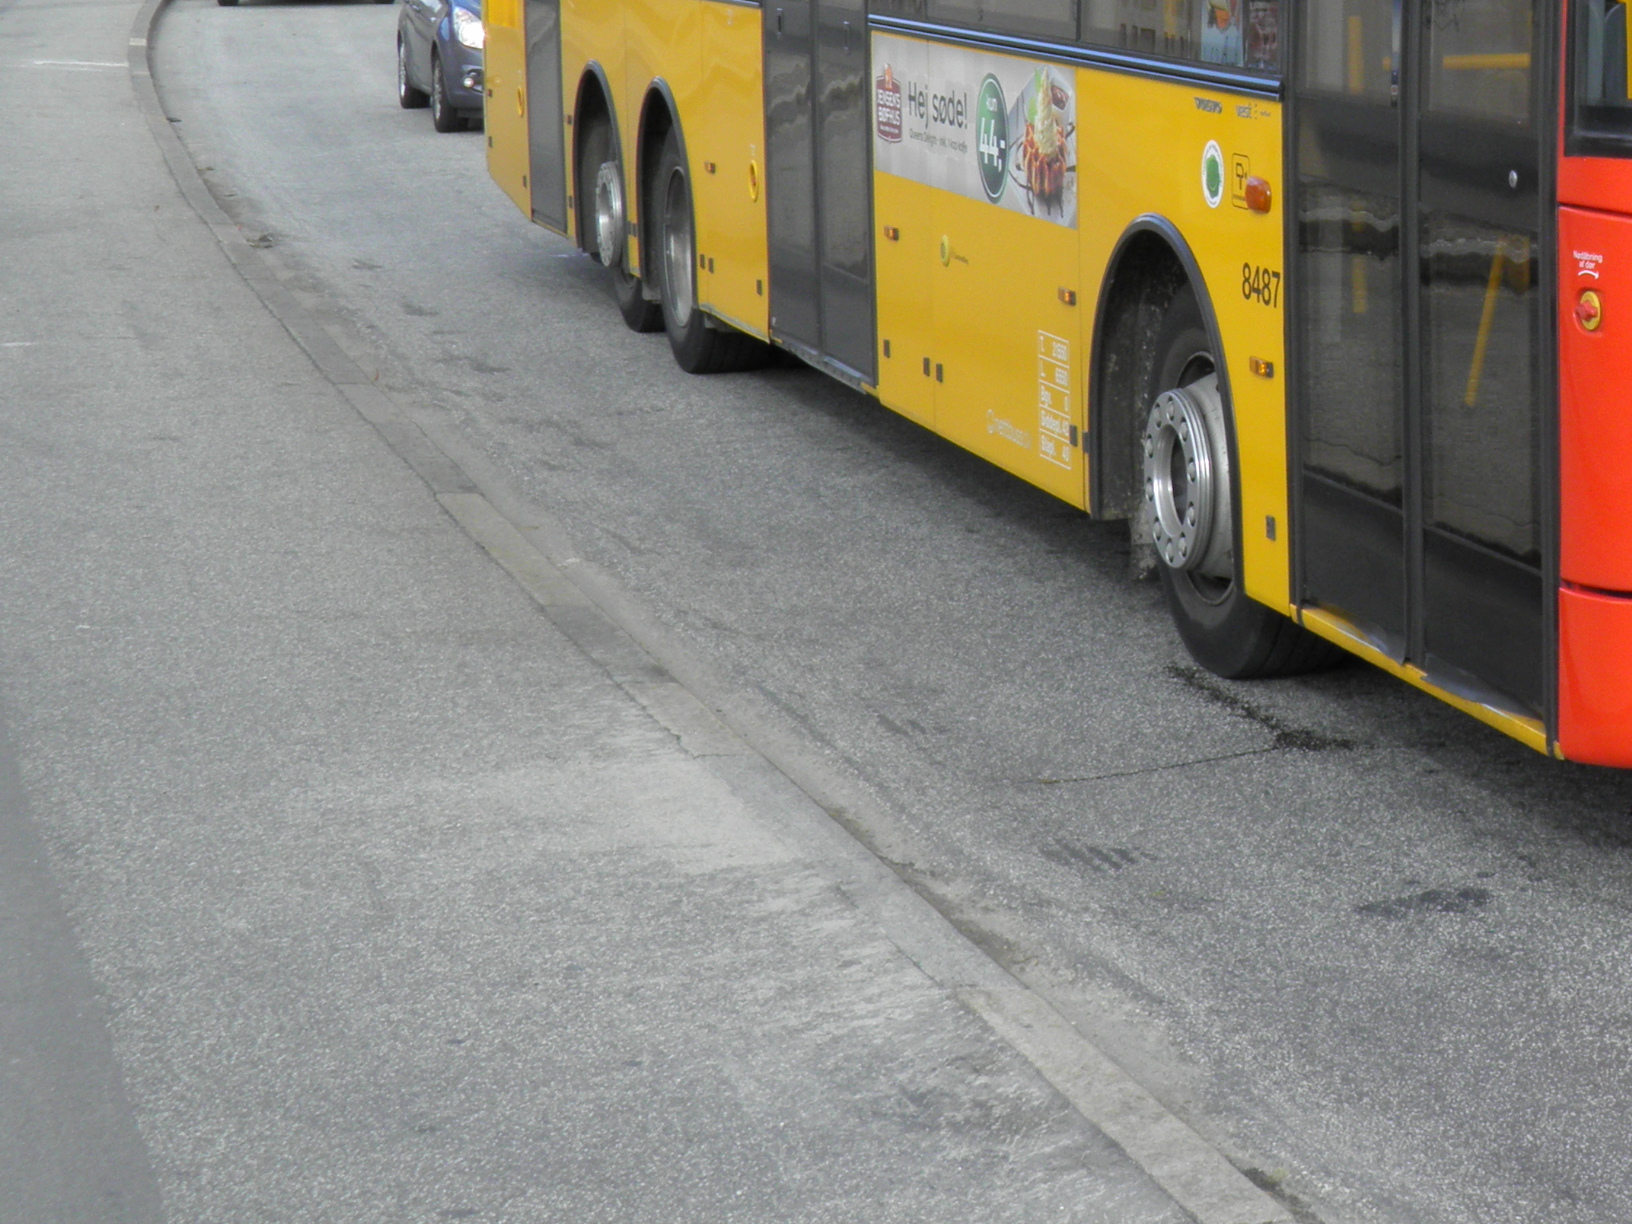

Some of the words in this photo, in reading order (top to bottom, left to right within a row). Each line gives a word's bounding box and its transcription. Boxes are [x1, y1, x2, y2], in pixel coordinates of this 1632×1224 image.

[908, 80, 929, 127] Hej
[932, 91, 968, 129] søde!
[1242, 262, 1280, 308] 8487
